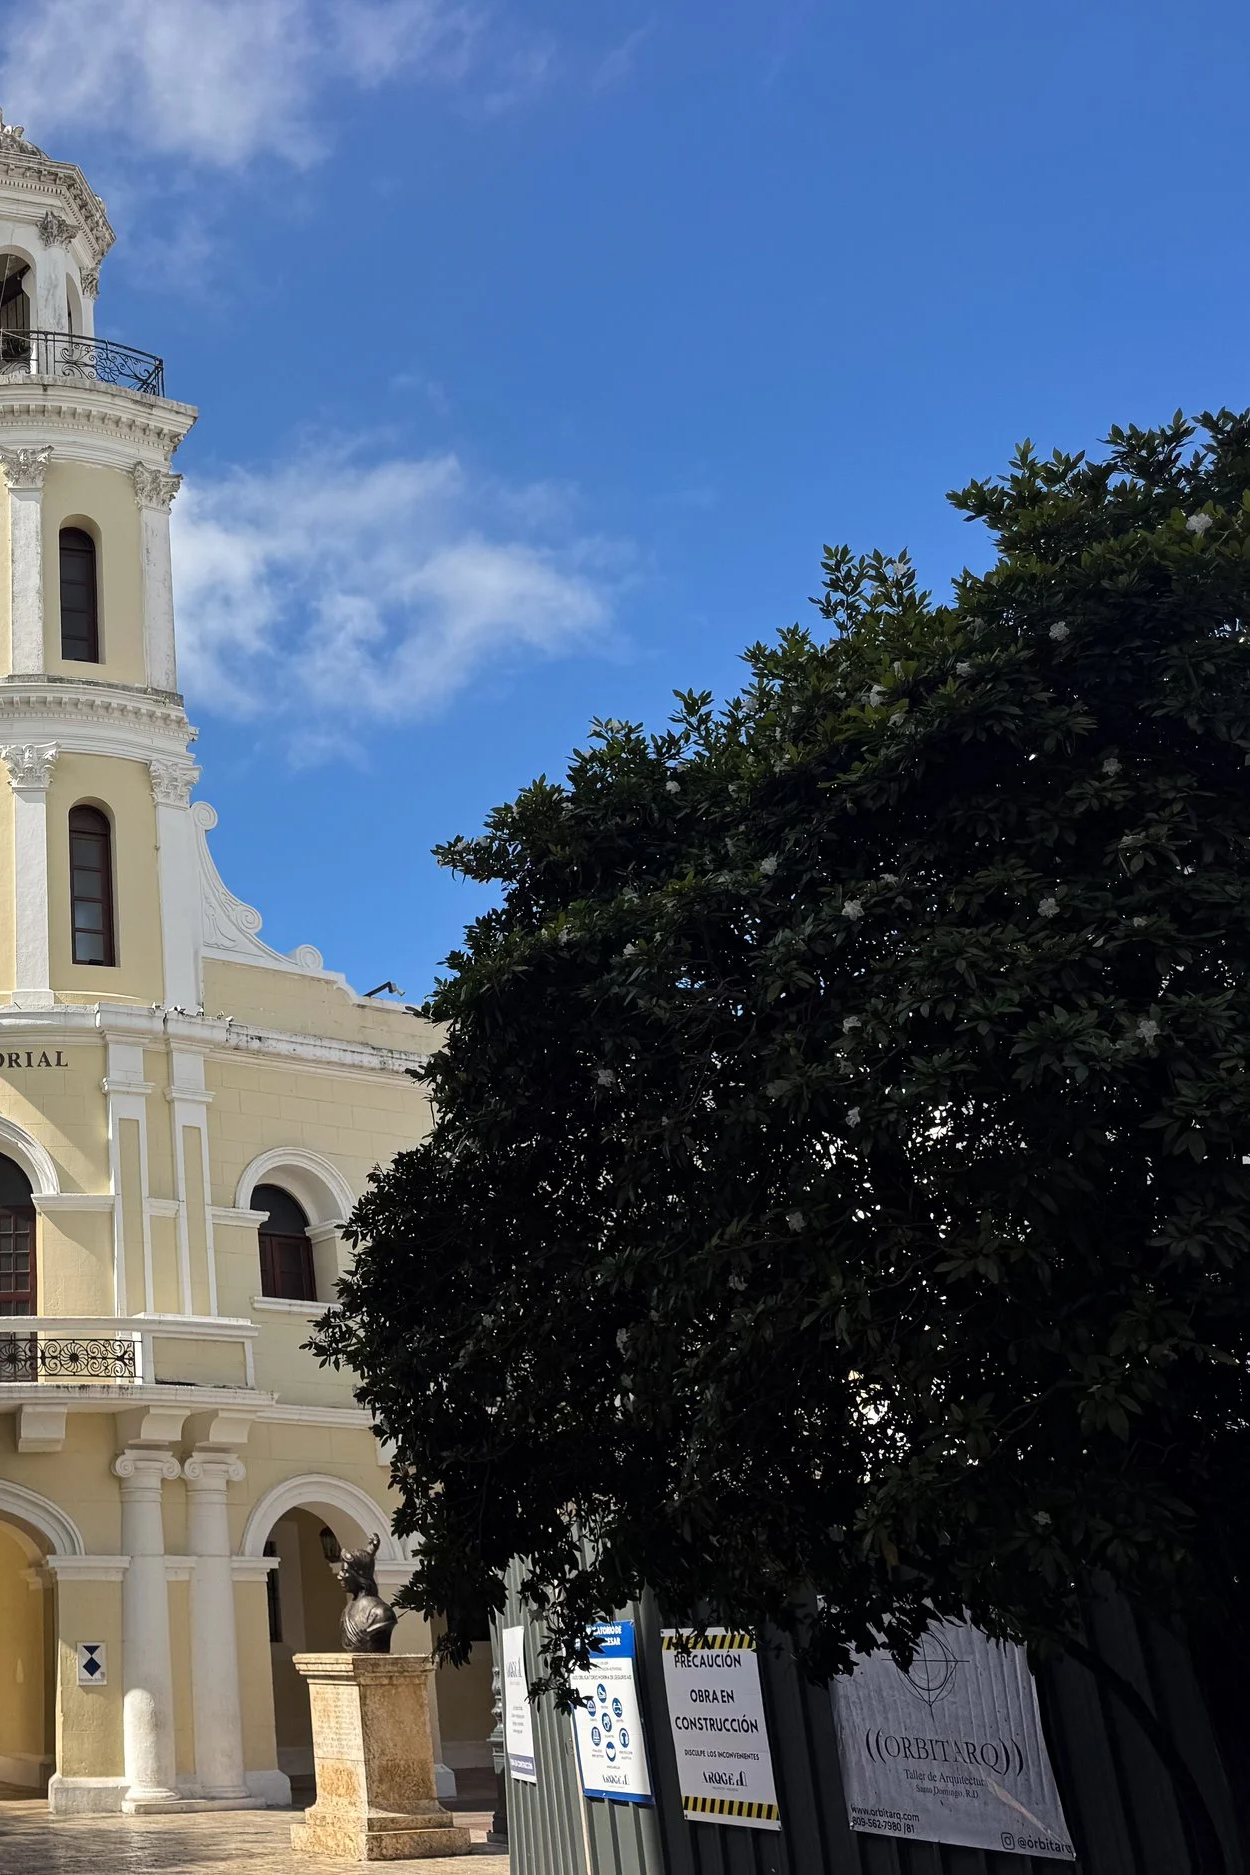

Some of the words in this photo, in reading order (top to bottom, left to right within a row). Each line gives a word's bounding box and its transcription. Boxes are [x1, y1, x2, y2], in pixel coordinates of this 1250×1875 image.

[674, 1651, 742, 1668] PRECAUCIÓN
[690, 1689, 720, 1703] OBRA
[721, 1690, 735, 1703] EN
[675, 1715, 759, 1733] CONSTRUCCIÓN
[684, 1749, 706, 1757] DISCULPE
[718, 1751, 759, 1760] INCONVENIENTES
[904, 1769, 926, 1783] Taller
[928, 1772, 938, 1782] de
[939, 1773, 988, 1787] Arquitectur
[851, 1806, 919, 1823] www.orbitarq.com
[852, 1817, 902, 1832] 809-562-7980
